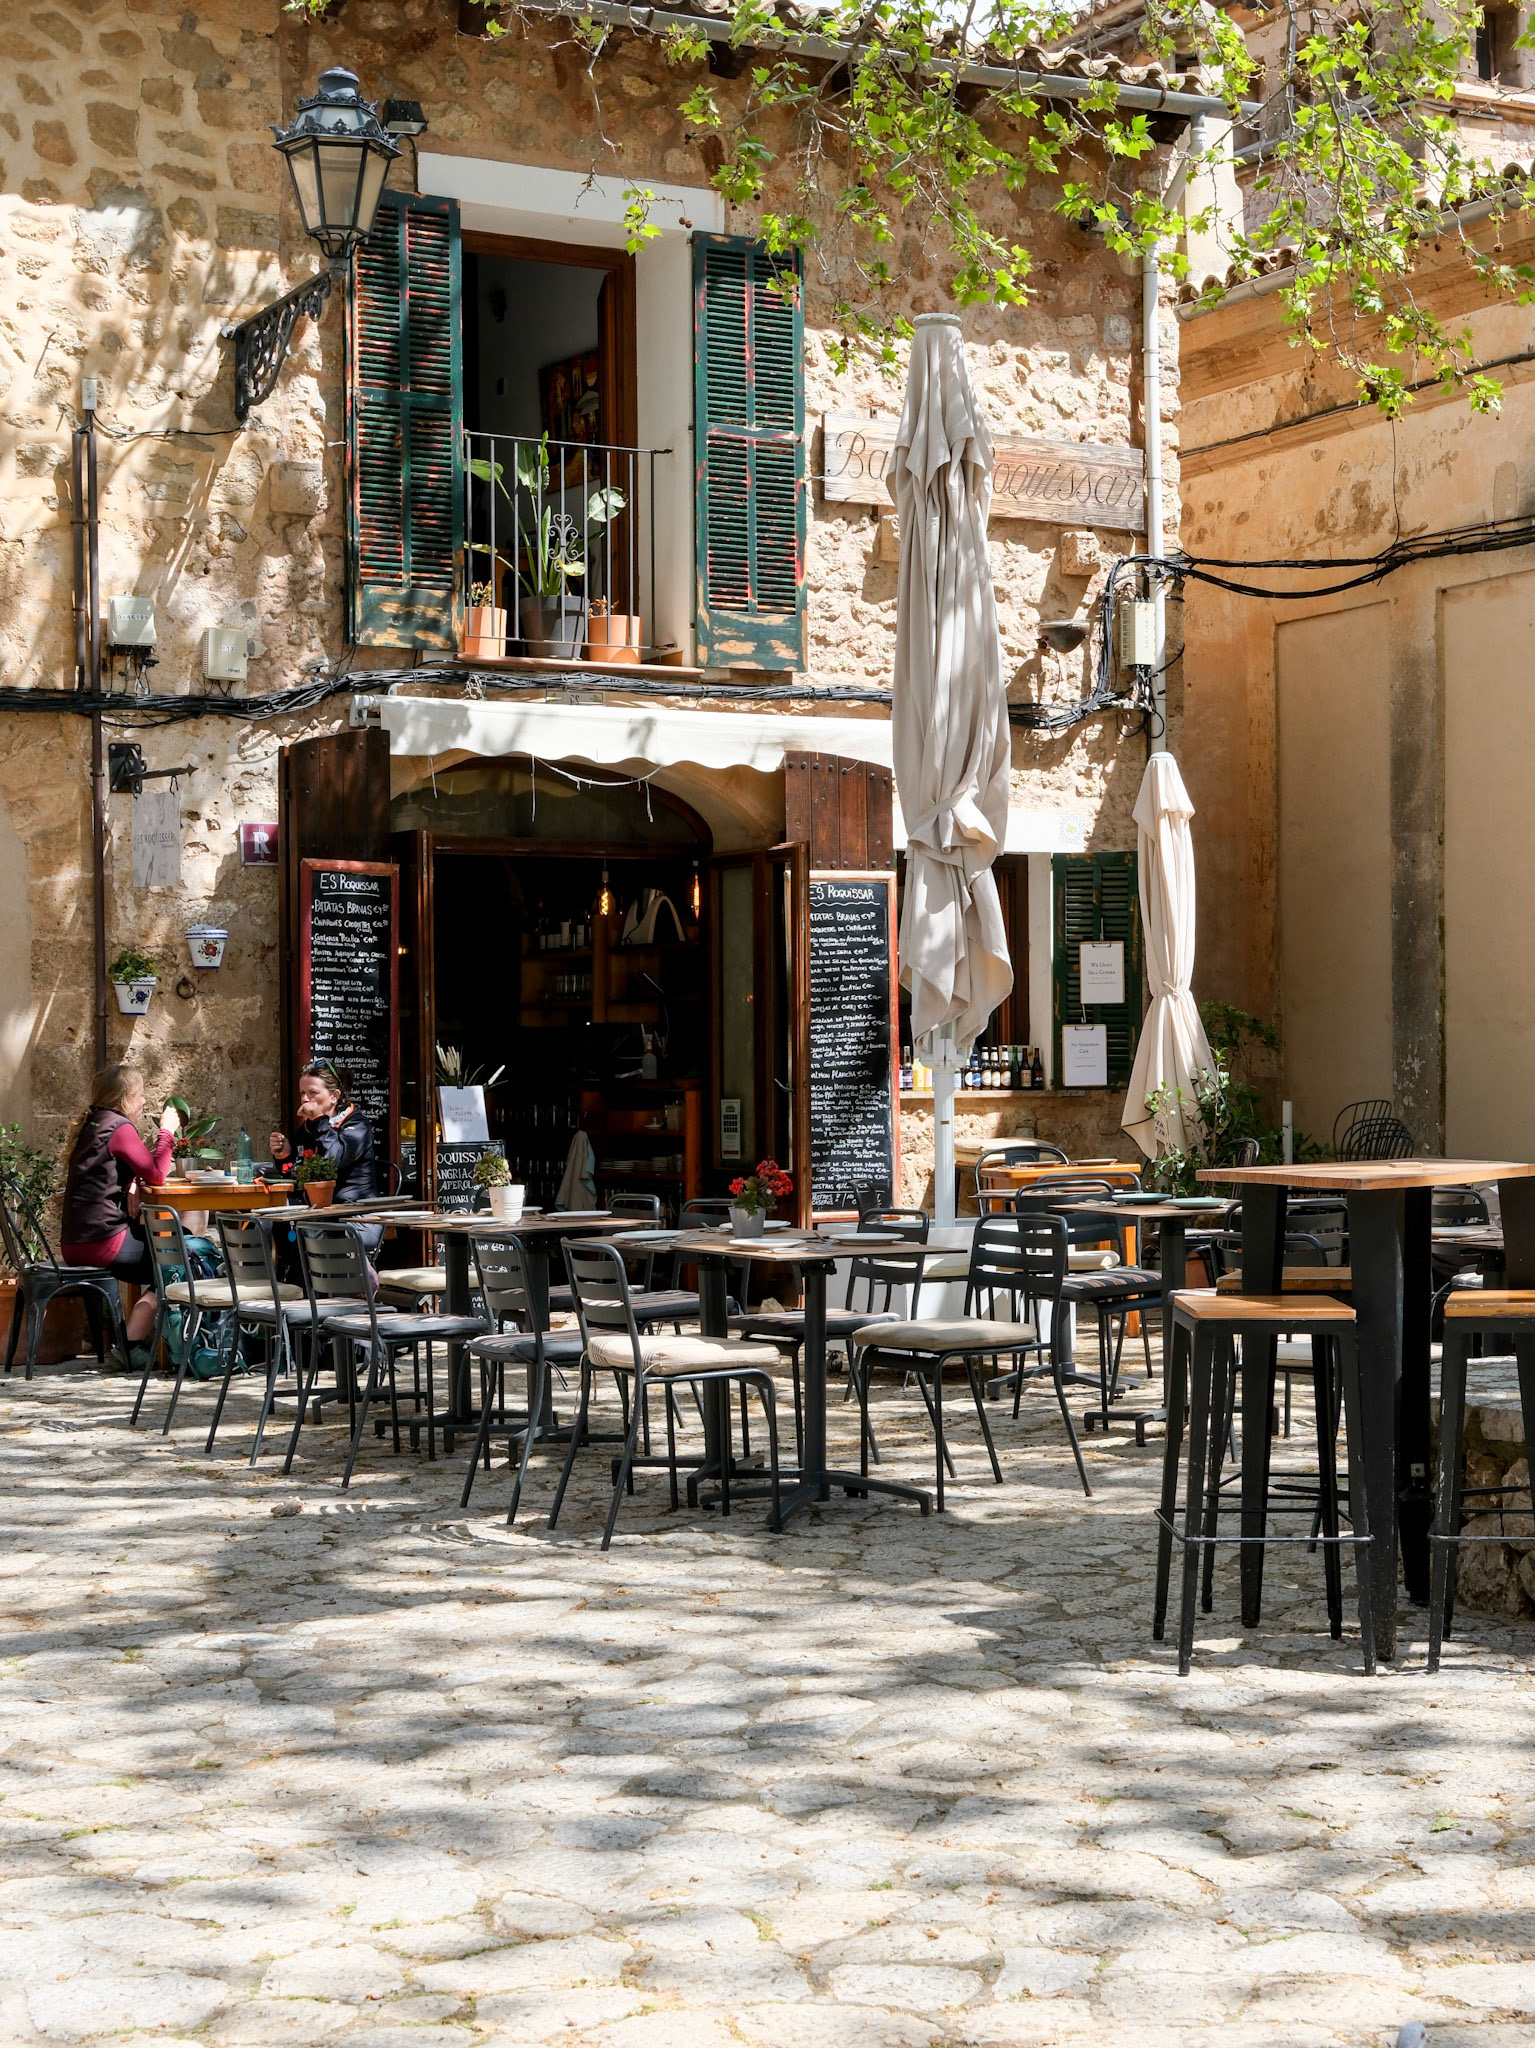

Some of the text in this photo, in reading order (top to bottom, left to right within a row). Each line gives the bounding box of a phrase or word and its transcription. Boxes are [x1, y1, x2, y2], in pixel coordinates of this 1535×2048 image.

[828, 427, 1138, 508] Ba oquissar
[320, 873, 337, 890] ES
[314, 899, 345, 914] PATATAS
[346, 901, 373, 916] BRAVAS
[810, 912, 834, 922] ATATAS
[810, 1070, 831, 1079] ALMON
[437, 1151, 488, 1166] OQUISSA
[437, 1168, 468, 1181] ANGRIA
[437, 1194, 470, 1205] CAMPARI
